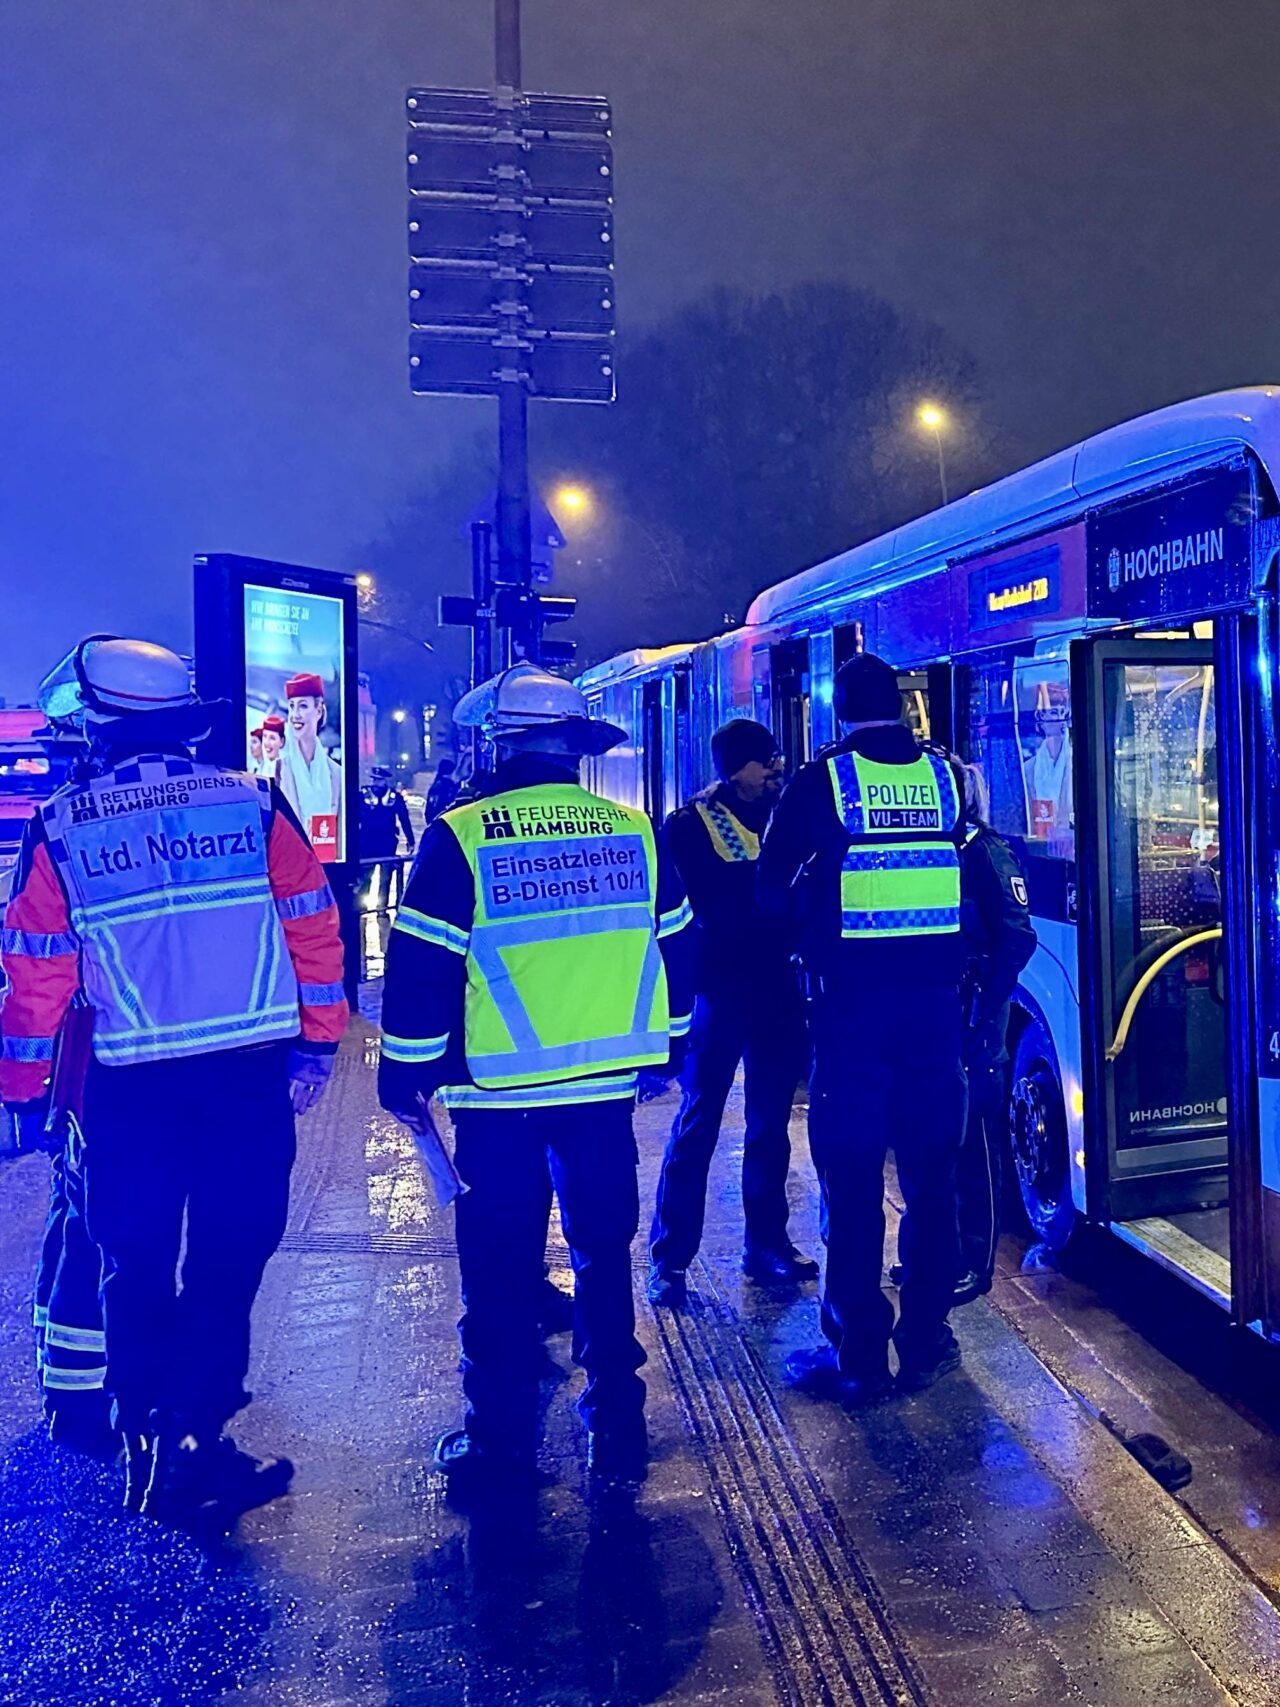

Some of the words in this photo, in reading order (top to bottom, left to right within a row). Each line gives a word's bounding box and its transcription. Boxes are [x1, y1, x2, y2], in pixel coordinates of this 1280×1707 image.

[1124, 528, 1223, 582] HOCHBAHN
[101, 777, 243, 804] RETTUNGSDIENST
[867, 784, 936, 806] POLIZEI
[103, 793, 190, 817] HAMBURG
[516, 805, 631, 822] FEUERWEHR
[520, 820, 613, 836] HAMBURG
[871, 811, 937, 827] VU-TEAM
[80, 841, 142, 878] Ltd.
[146, 825, 257, 864] Notarzt
[492, 847, 636, 878] Einsatzleiter
[492, 873, 599, 905] B-Dienst
[605, 870, 644, 892] 10/1
